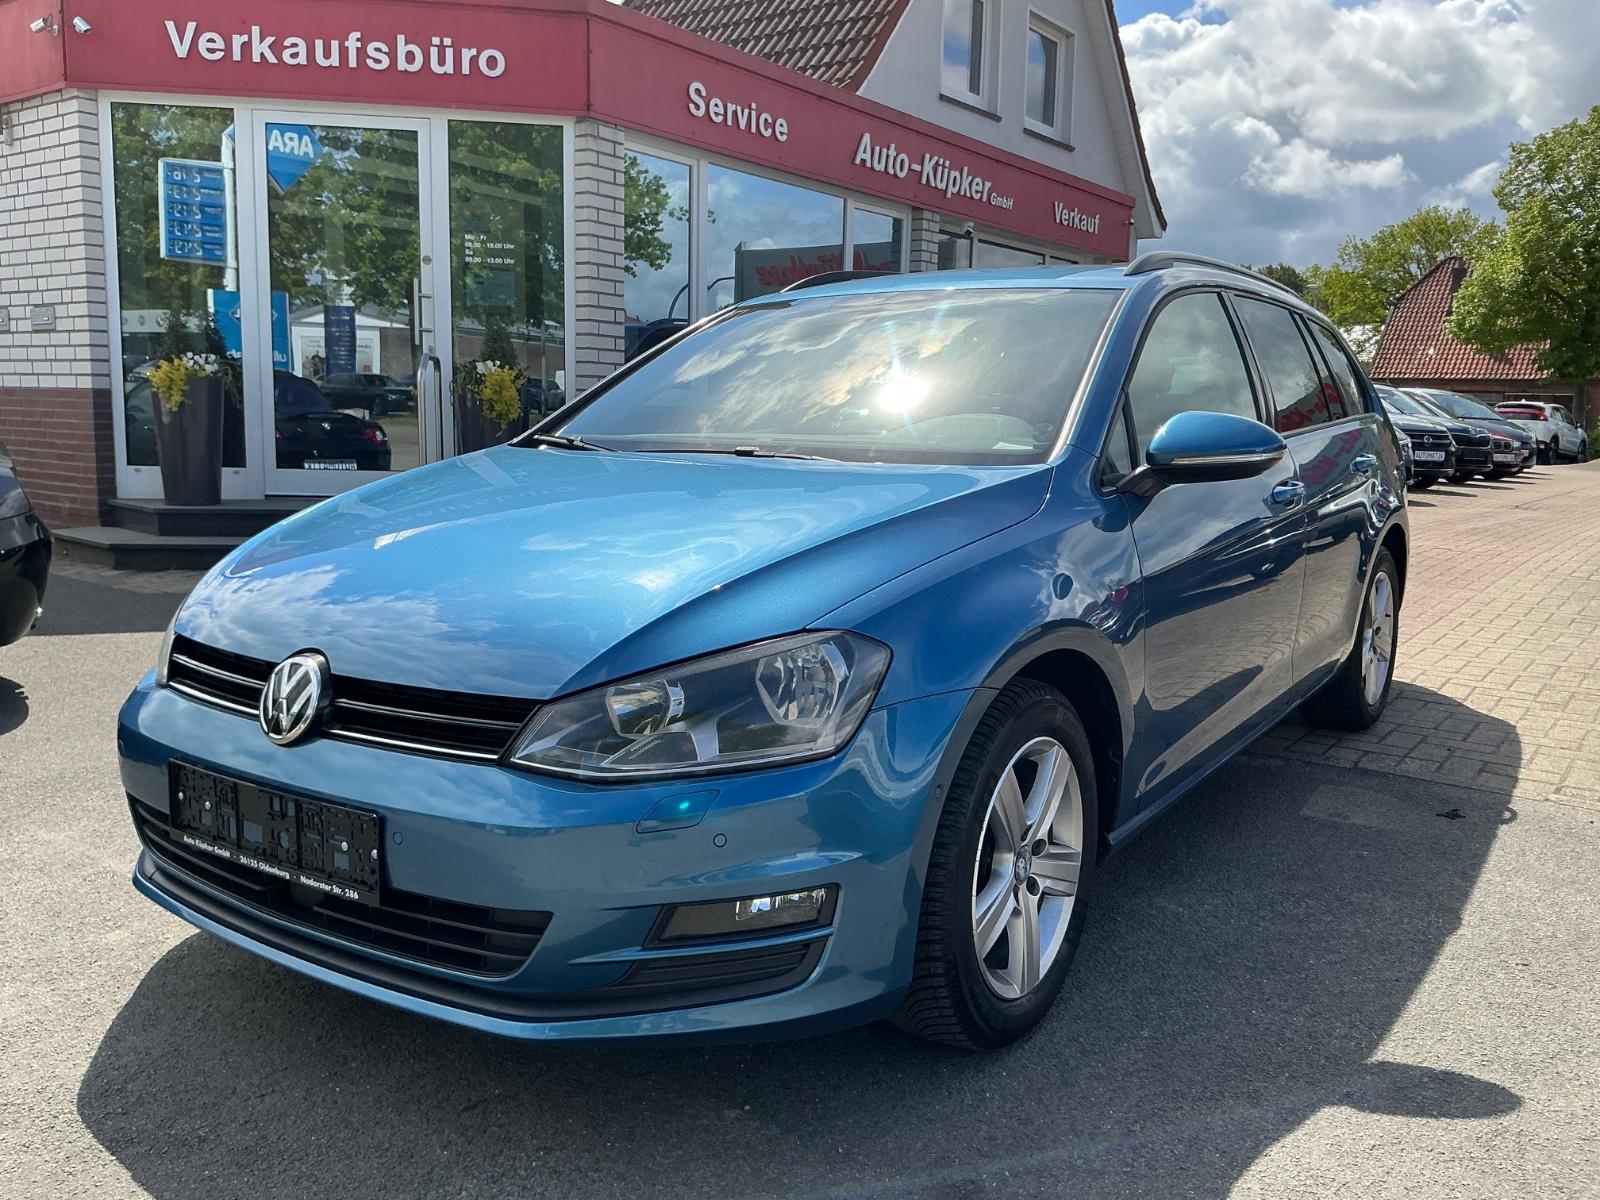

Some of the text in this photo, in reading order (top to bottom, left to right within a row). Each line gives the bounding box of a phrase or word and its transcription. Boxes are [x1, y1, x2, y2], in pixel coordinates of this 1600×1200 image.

[164, 20, 506, 78] Verkaufsbüro
[688, 81, 788, 142] Service
[854, 132, 1014, 211] Auto-Küpker GmbH
[1053, 200, 1101, 234] Verkauf
[259, 862, 290, 880] Oldenburg
[345, 888, 359, 900] 286
